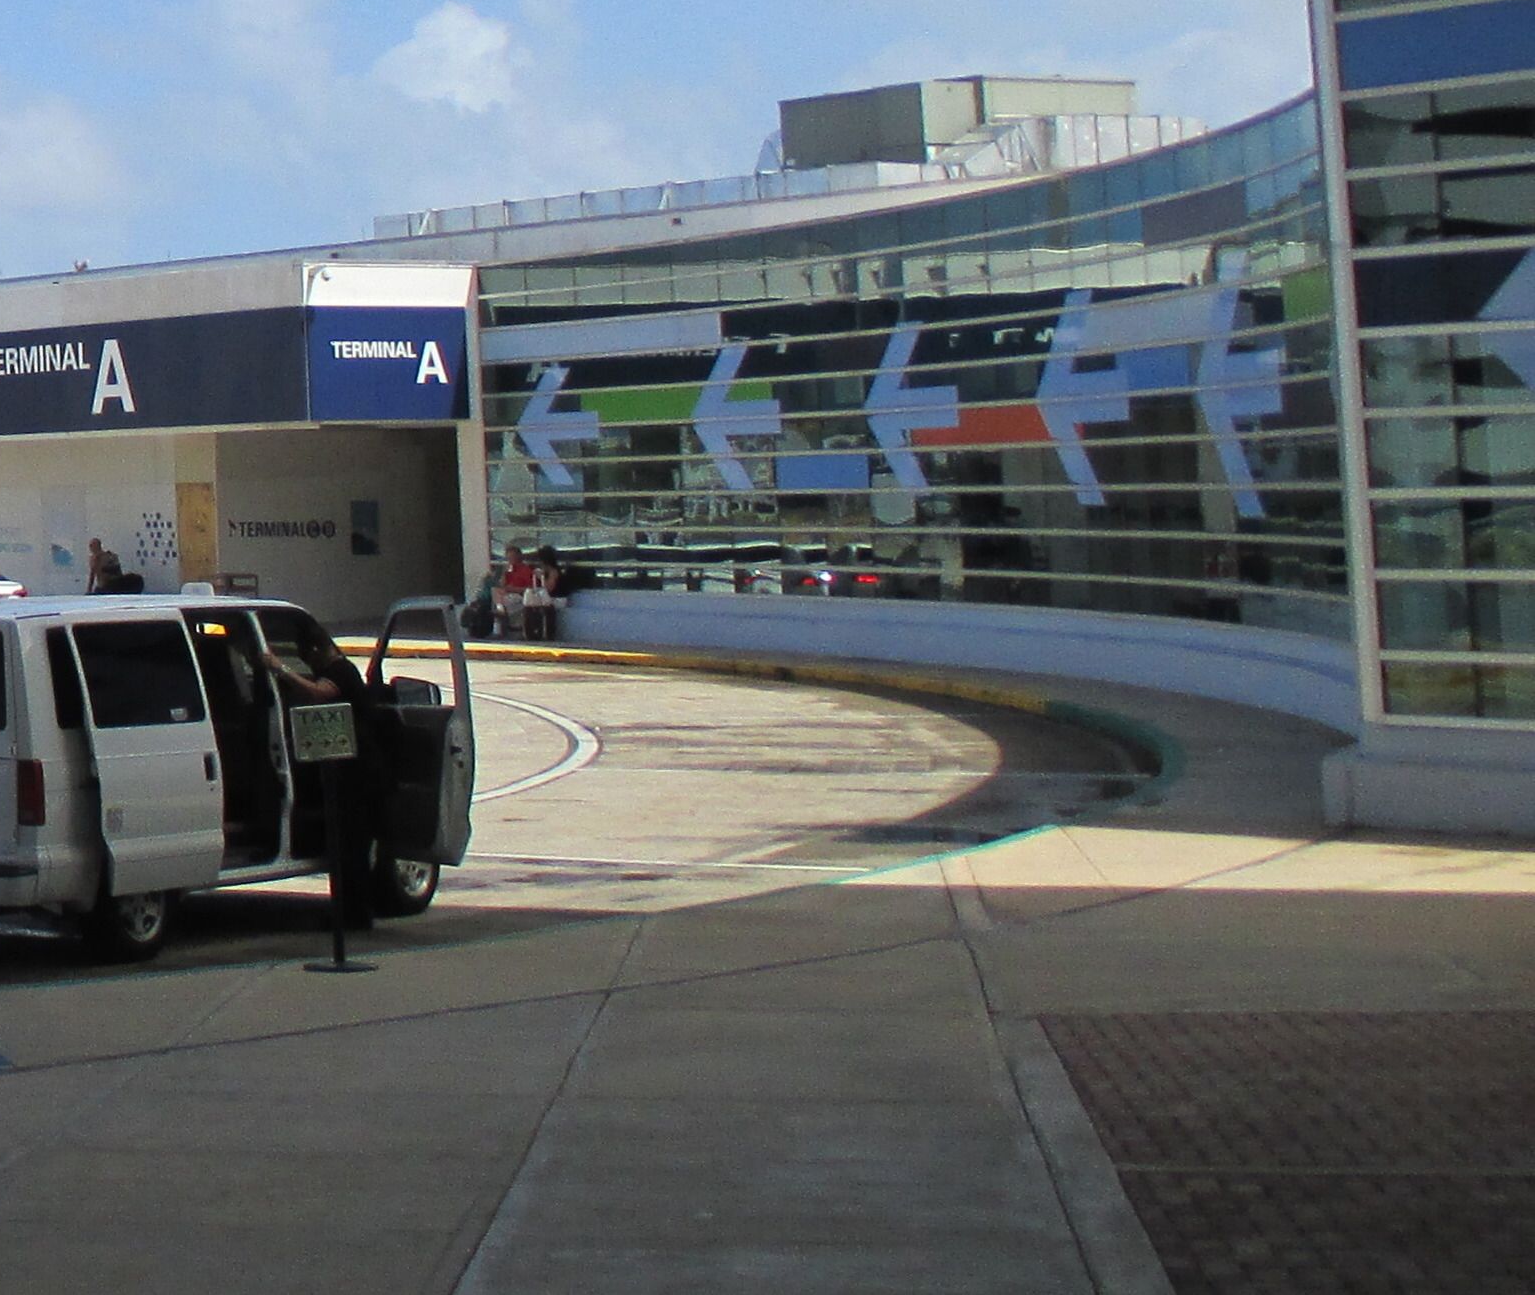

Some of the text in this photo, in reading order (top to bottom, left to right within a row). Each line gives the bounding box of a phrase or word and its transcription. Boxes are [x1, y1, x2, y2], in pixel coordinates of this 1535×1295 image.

[91, 339, 136, 415] A
[330, 341, 449, 384] TERMINAL A
[239, 520, 306, 538] TERMINAL
[297, 711, 346, 725] TAXI
